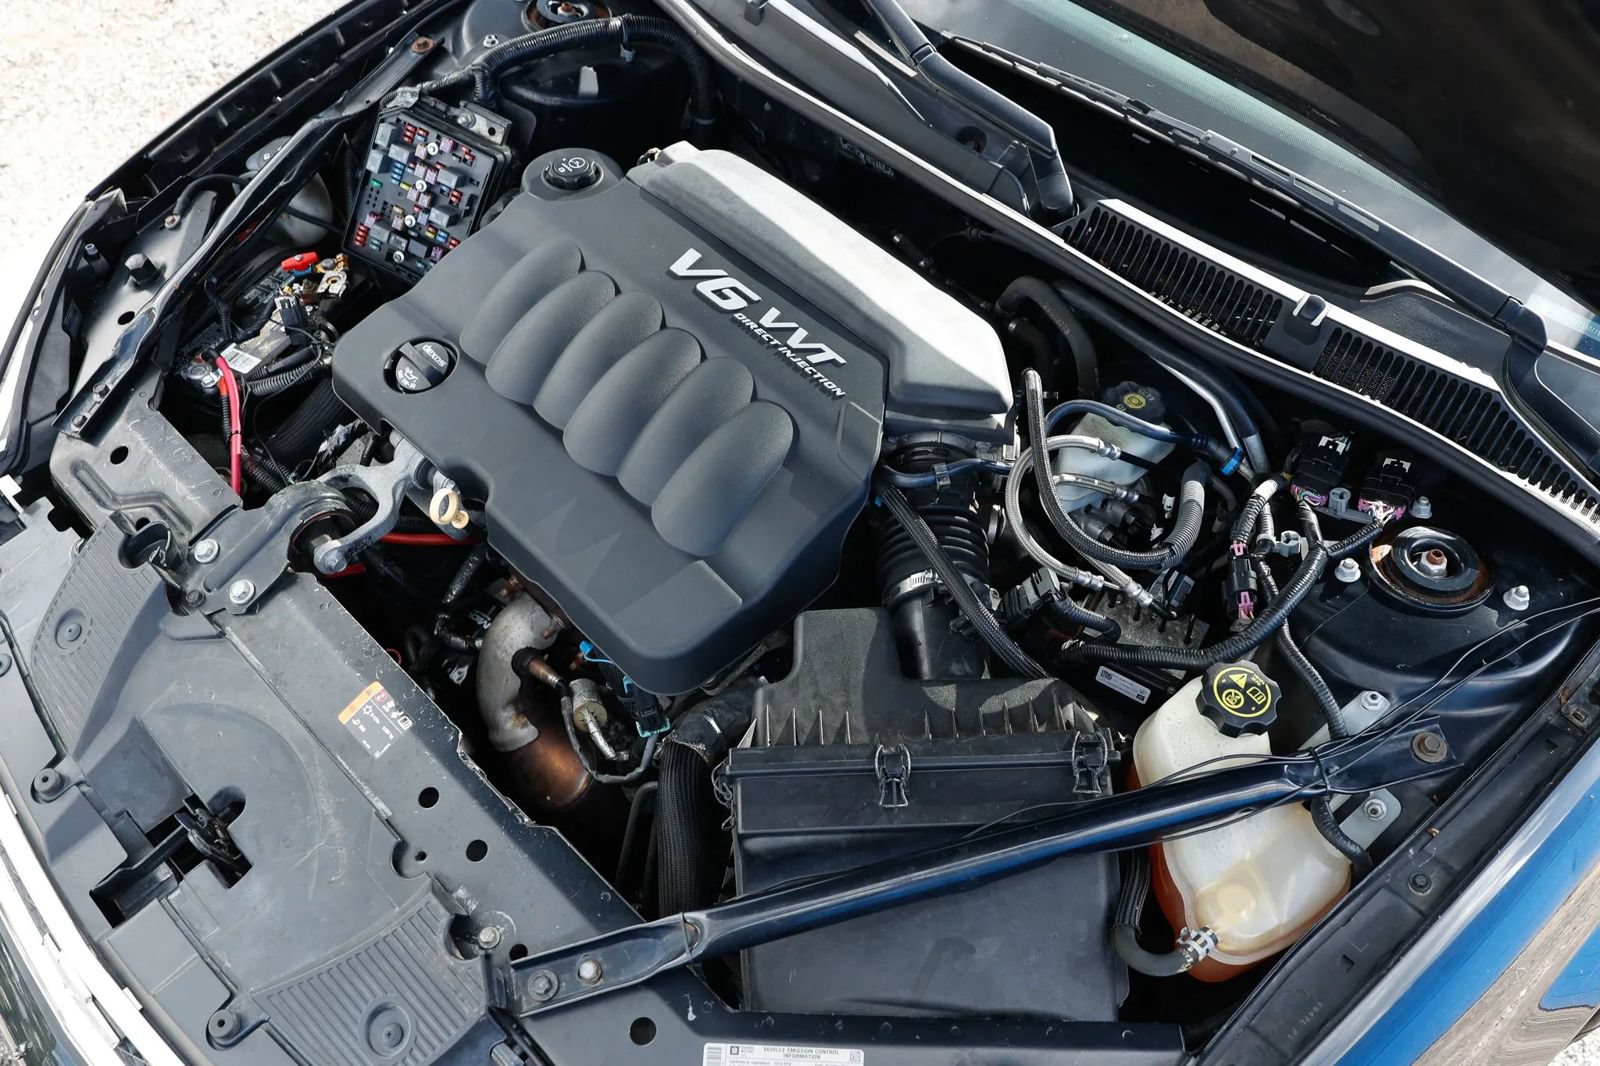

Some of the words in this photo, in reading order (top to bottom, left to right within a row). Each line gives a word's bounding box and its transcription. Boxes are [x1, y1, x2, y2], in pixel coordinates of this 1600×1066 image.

[669, 248, 762, 311] V6
[759, 307, 847, 364] VVT
[422, 344, 447, 367] dexos
[733, 312, 783, 346] DIRECT
[778, 346, 846, 397] INJECTION
